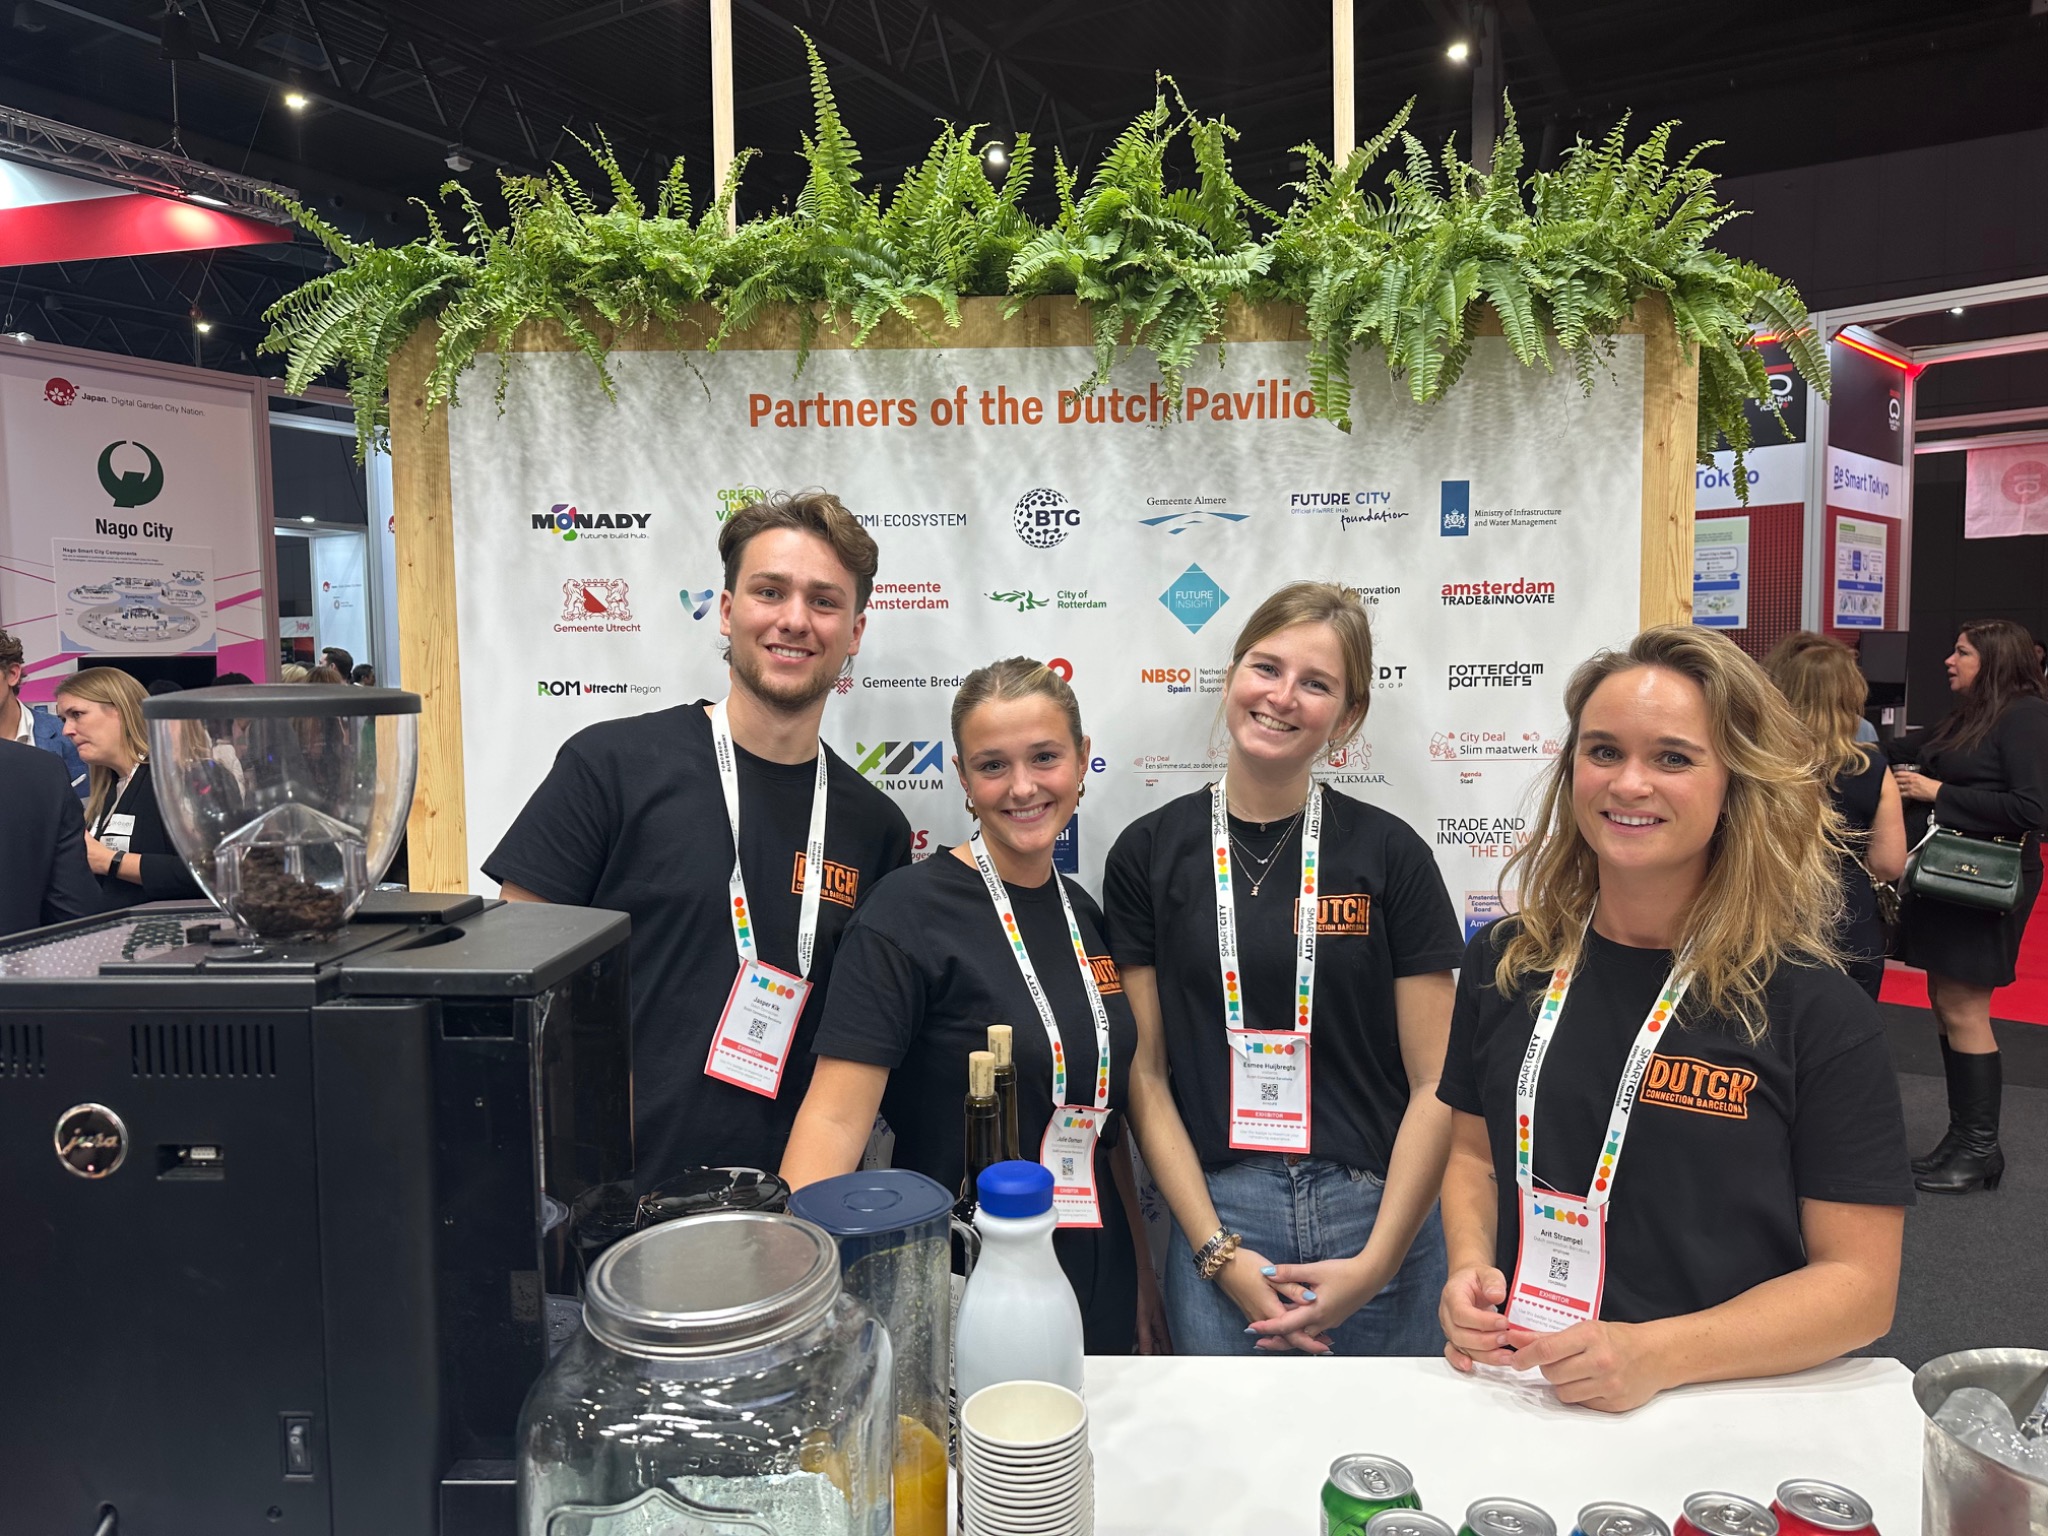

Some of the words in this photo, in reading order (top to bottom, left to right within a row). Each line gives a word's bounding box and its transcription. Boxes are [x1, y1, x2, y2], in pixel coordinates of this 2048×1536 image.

[82, 393, 108, 402] Japan.
[112, 396, 134, 406] Digital
[137, 400, 163, 410] Garden
[165, 404, 179, 414] City
[180, 406, 205, 416] Nation.
[749, 391, 917, 428] Partners
[931, 385, 967, 427] of
[980, 385, 1043, 425] the
[1058, 378, 1169, 424] Dutch
[1186, 379, 1316, 421] Pavilio
[1696, 469, 1759, 489] Toko
[1834, 465, 1843, 484] Be
[1845, 468, 1867, 491] Smart
[1868, 474, 1889, 499] Tokyo
[1147, 497, 1192, 506] Gemeente
[1194, 496, 1227, 505] Almere
[1291, 492, 1350, 506] FUTURE
[1355, 492, 1391, 505] CITY
[1035, 509, 1080, 526] BTG
[1340, 508, 1409, 532] foundation
[1474, 509, 1503, 518] Ministry
[1504, 508, 1513, 516] of
[1514, 508, 1562, 516] Infrastructure
[532, 513, 652, 530] MONADY
[1474, 519, 1487, 527] and
[1511, 518, 1557, 527] Management
[95, 518, 138, 539] Nago
[143, 521, 173, 541] City
[871, 582, 941, 594] emeente
[1441, 577, 1555, 595] amsterdam
[1057, 590, 1075, 600] City
[1077, 590, 1088, 599] of
[1175, 590, 1213, 600] FUTURE
[1363, 596, 1379, 605] life
[1441, 594, 1555, 605] TRADE&INNOVATE
[1057, 599, 1107, 609] Rotterdam
[1175, 599, 1212, 609] INSIGHT
[554, 623, 603, 633] Gemeente
[606, 623, 641, 633] Utrecht
[862, 677, 927, 689] Gemeente
[930, 675, 966, 688] Breda
[1141, 668, 1191, 684] NBSO
[538, 681, 580, 696] ROM
[584, 682, 628, 694] Utrecht
[630, 683, 661, 695] Region
[1167, 684, 1191, 694] Spain
[1460, 732, 1479, 743] City
[1482, 732, 1505, 742] Deal
[1460, 744, 1482, 754] Slim
[1485, 743, 1538, 754] maatwerk
[1334, 775, 1394, 786] ALKMAAR
[1460, 771, 1482, 779] Agenda
[1310, 793, 1321, 840] SMARTCITY
[1437, 819, 1488, 831] TRADE
[1492, 818, 1525, 830] AND
[1437, 832, 1511, 845] INNOVATE
[1469, 845, 1498, 857] THE
[976, 855, 1002, 901] SMARTCITY
[1316, 898, 1366, 924] UTCH
[1219, 904, 1230, 957] SMARTCITY
[1305, 907, 1315, 962] SMARTCITY
[753, 997, 771, 1008] Jasper
[772, 1002, 780, 1011] Kik
[1026, 974, 1052, 1027] SMARTCITY
[1091, 980, 1109, 1032] SMARTCITY
[1264, 1063, 1296, 1072] Huijbregts
[1518, 1034, 1541, 1096] SMARTCITY
[1621, 1047, 1651, 1115] SMARTCITY
[1648, 1059, 1751, 1103] DUTCH
[1645, 1088, 1694, 1106] CONNECTION
[1696, 1098, 1744, 1114] BARCELONA
[62, 1128, 118, 1154] jura
[1541, 1229, 1552, 1238] Arit
[1554, 1232, 1583, 1245] Strampel
[1539, 1290, 1570, 1304] EXHIBITOR
